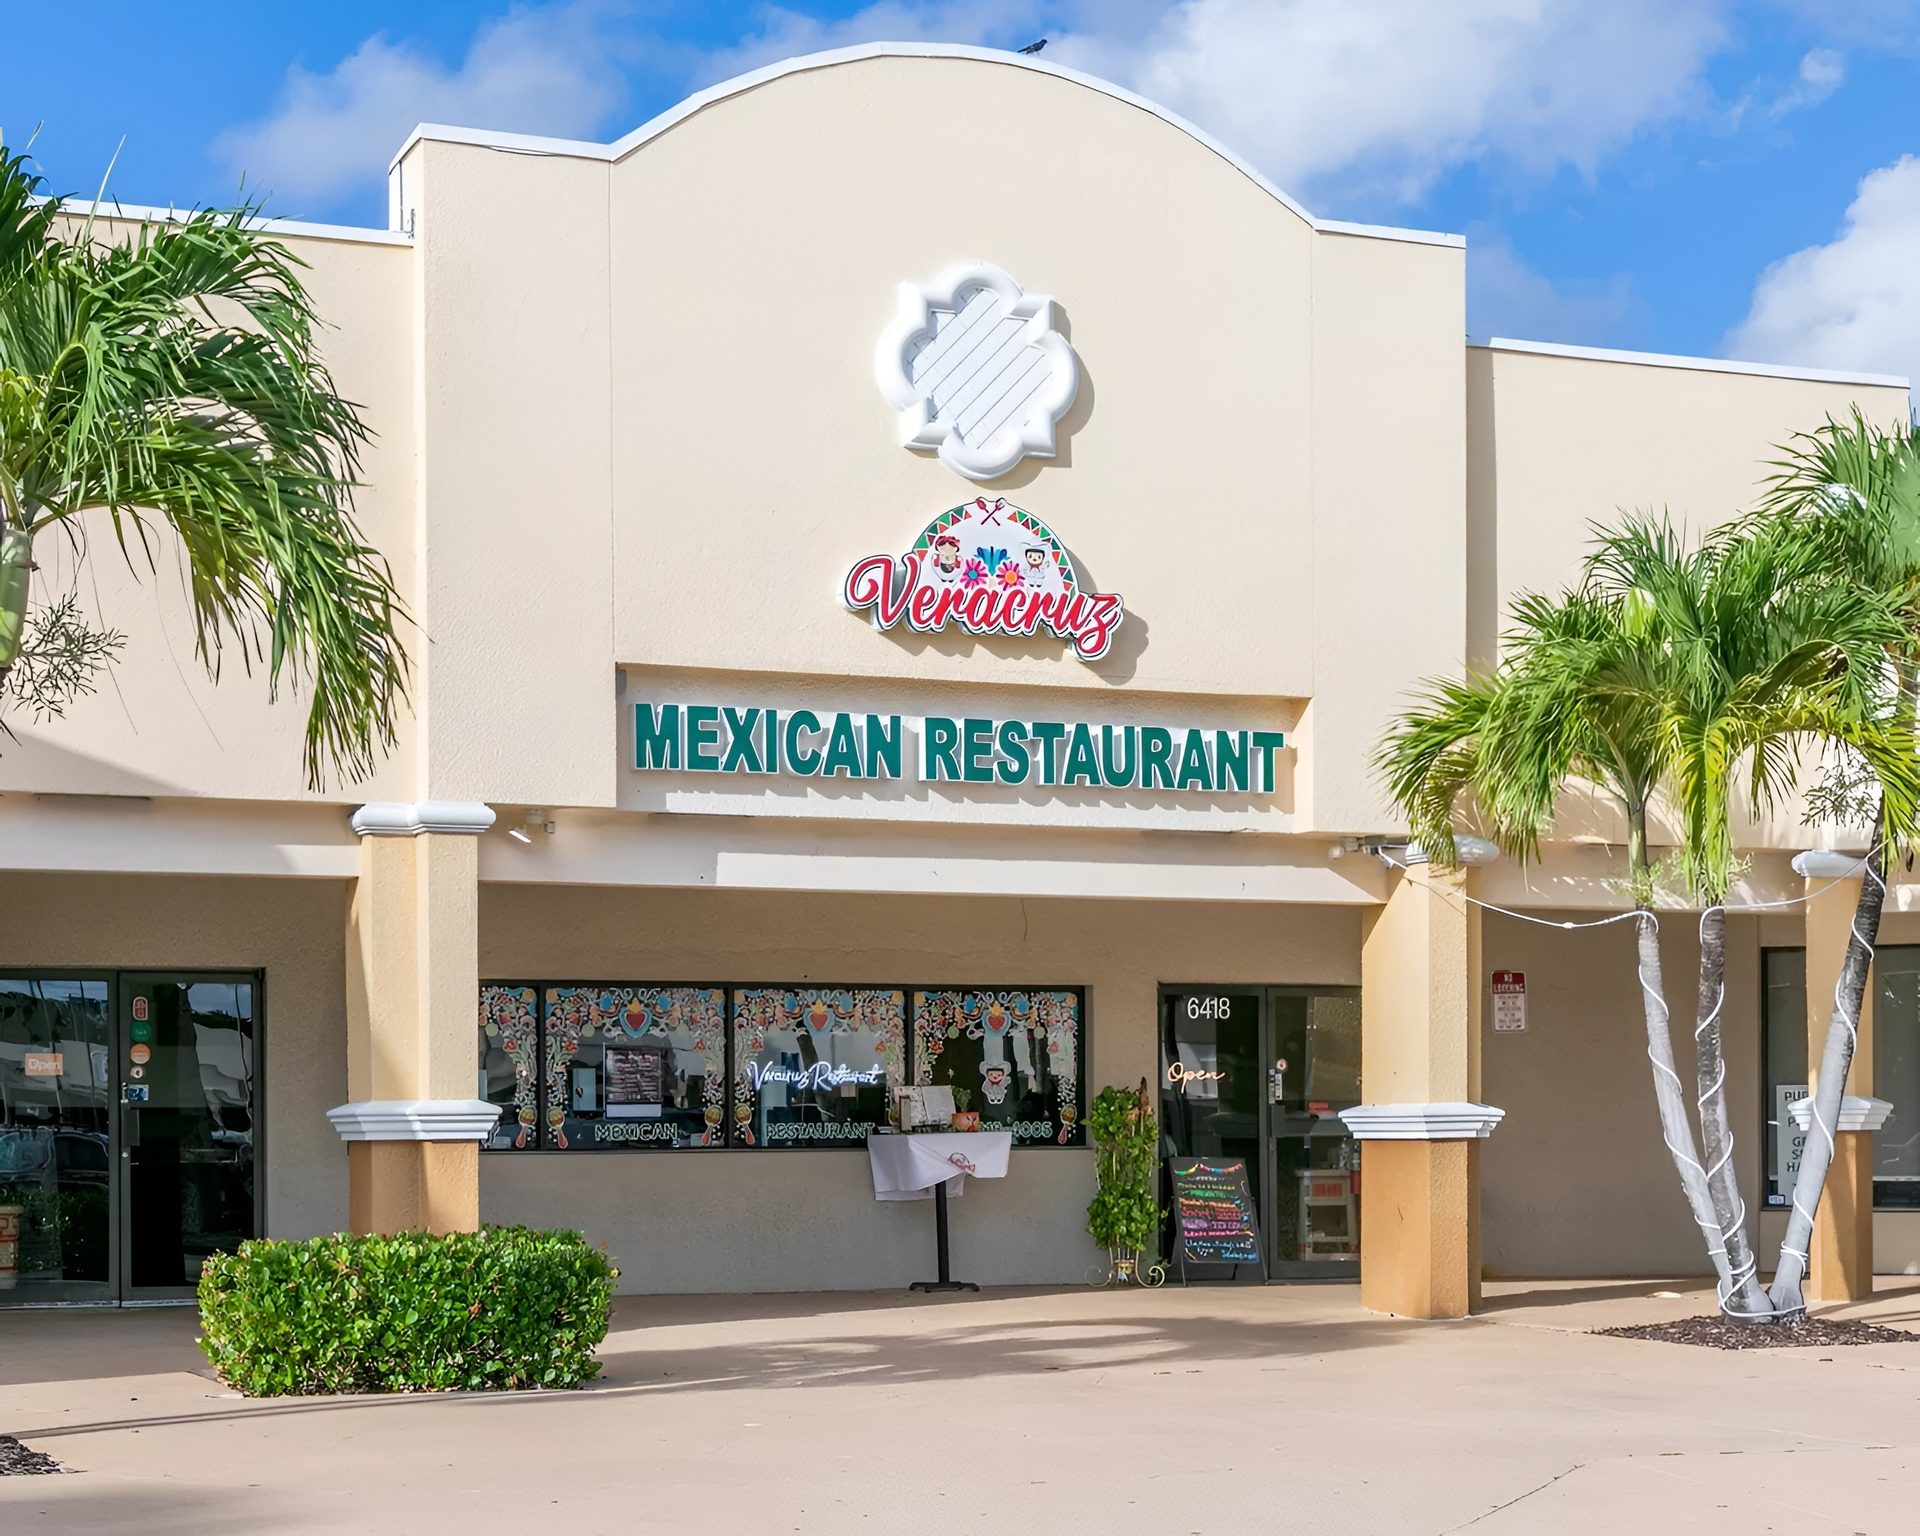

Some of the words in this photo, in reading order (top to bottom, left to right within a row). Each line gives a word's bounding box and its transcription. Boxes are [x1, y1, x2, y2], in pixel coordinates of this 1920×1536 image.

[847, 554, 1121, 657] Veracruz
[633, 703, 902, 780] MEXICAN
[920, 716, 1285, 793] RESTAURANT
[1187, 997, 1231, 1020] 6418
[1168, 1062, 1226, 1094] Open
